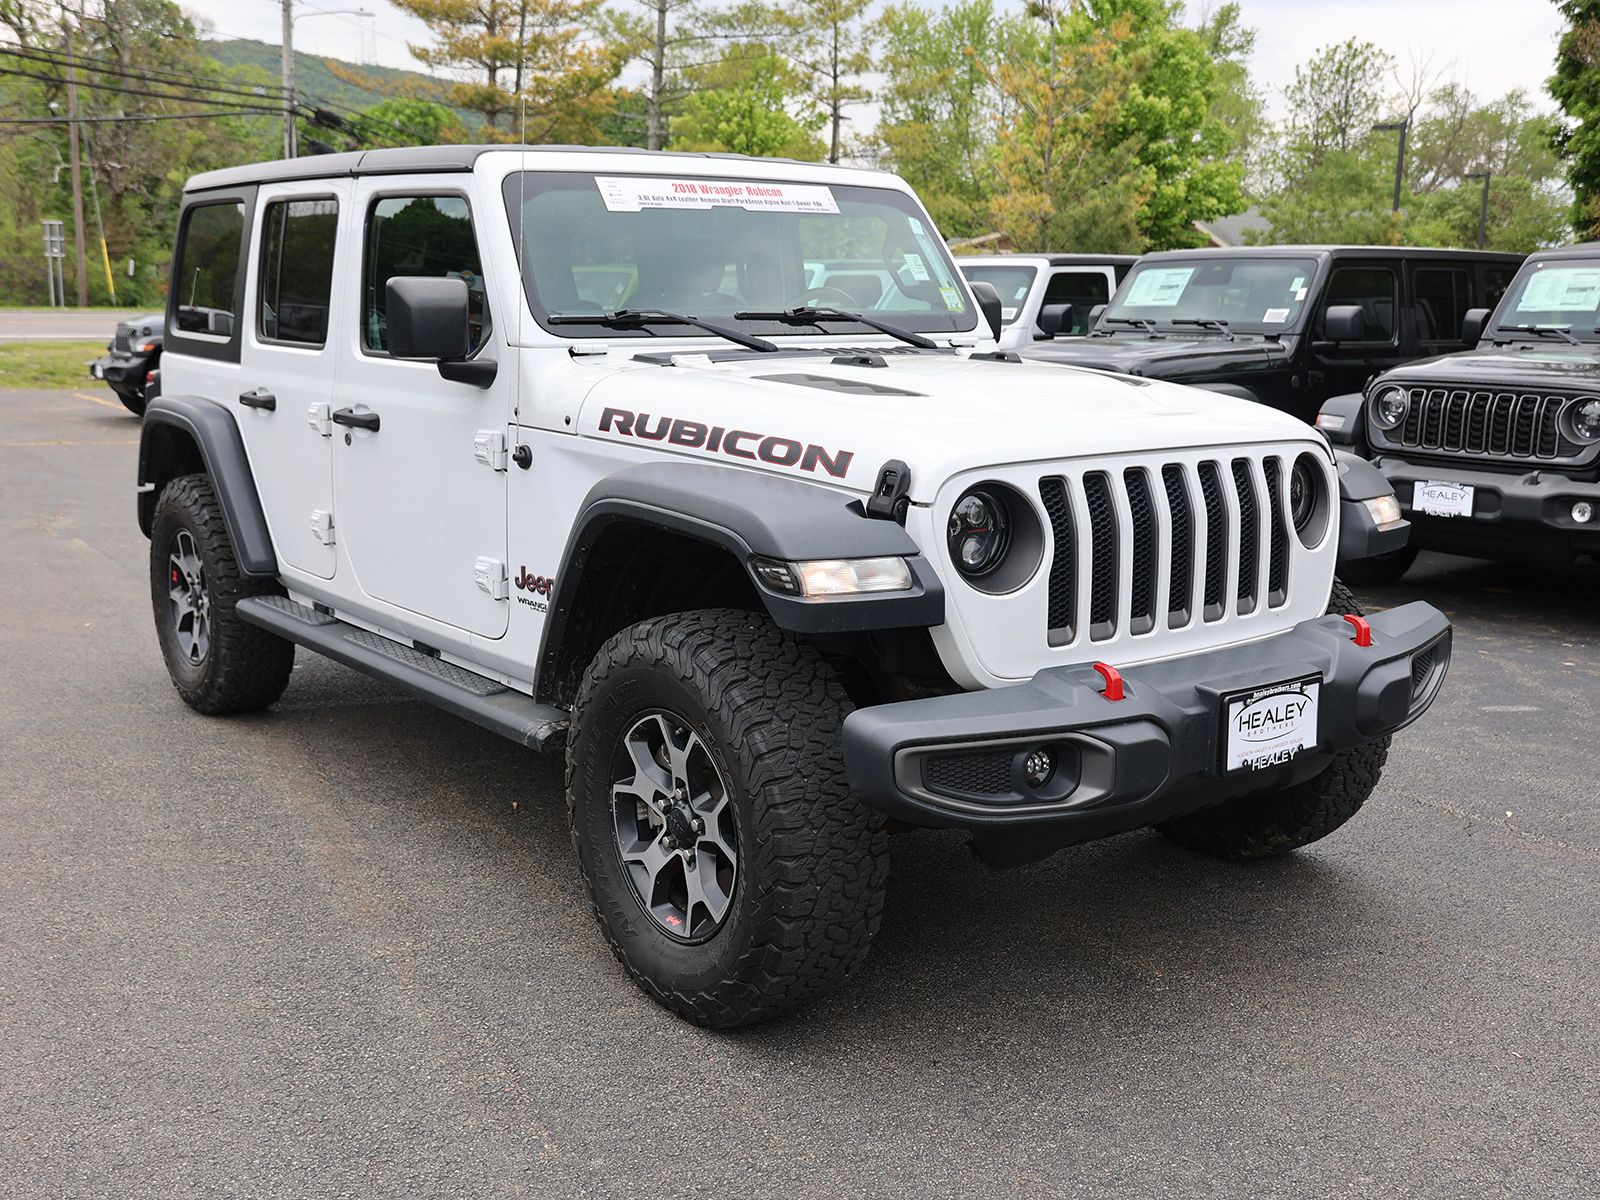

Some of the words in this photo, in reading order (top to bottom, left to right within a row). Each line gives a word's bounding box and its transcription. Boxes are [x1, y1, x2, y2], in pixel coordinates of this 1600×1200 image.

[671, 183, 698, 194] 2018
[698, 184, 743, 197] Wrangler
[745, 186, 784, 197] Rubicon
[598, 407, 854, 479] RUBICON
[1422, 490, 1466, 500] HEALEY
[514, 565, 555, 602] Jeep
[1238, 699, 1307, 733] HEALEY
[1247, 721, 1295, 737] BROTHERS
[1251, 747, 1296, 771] HEALEY
